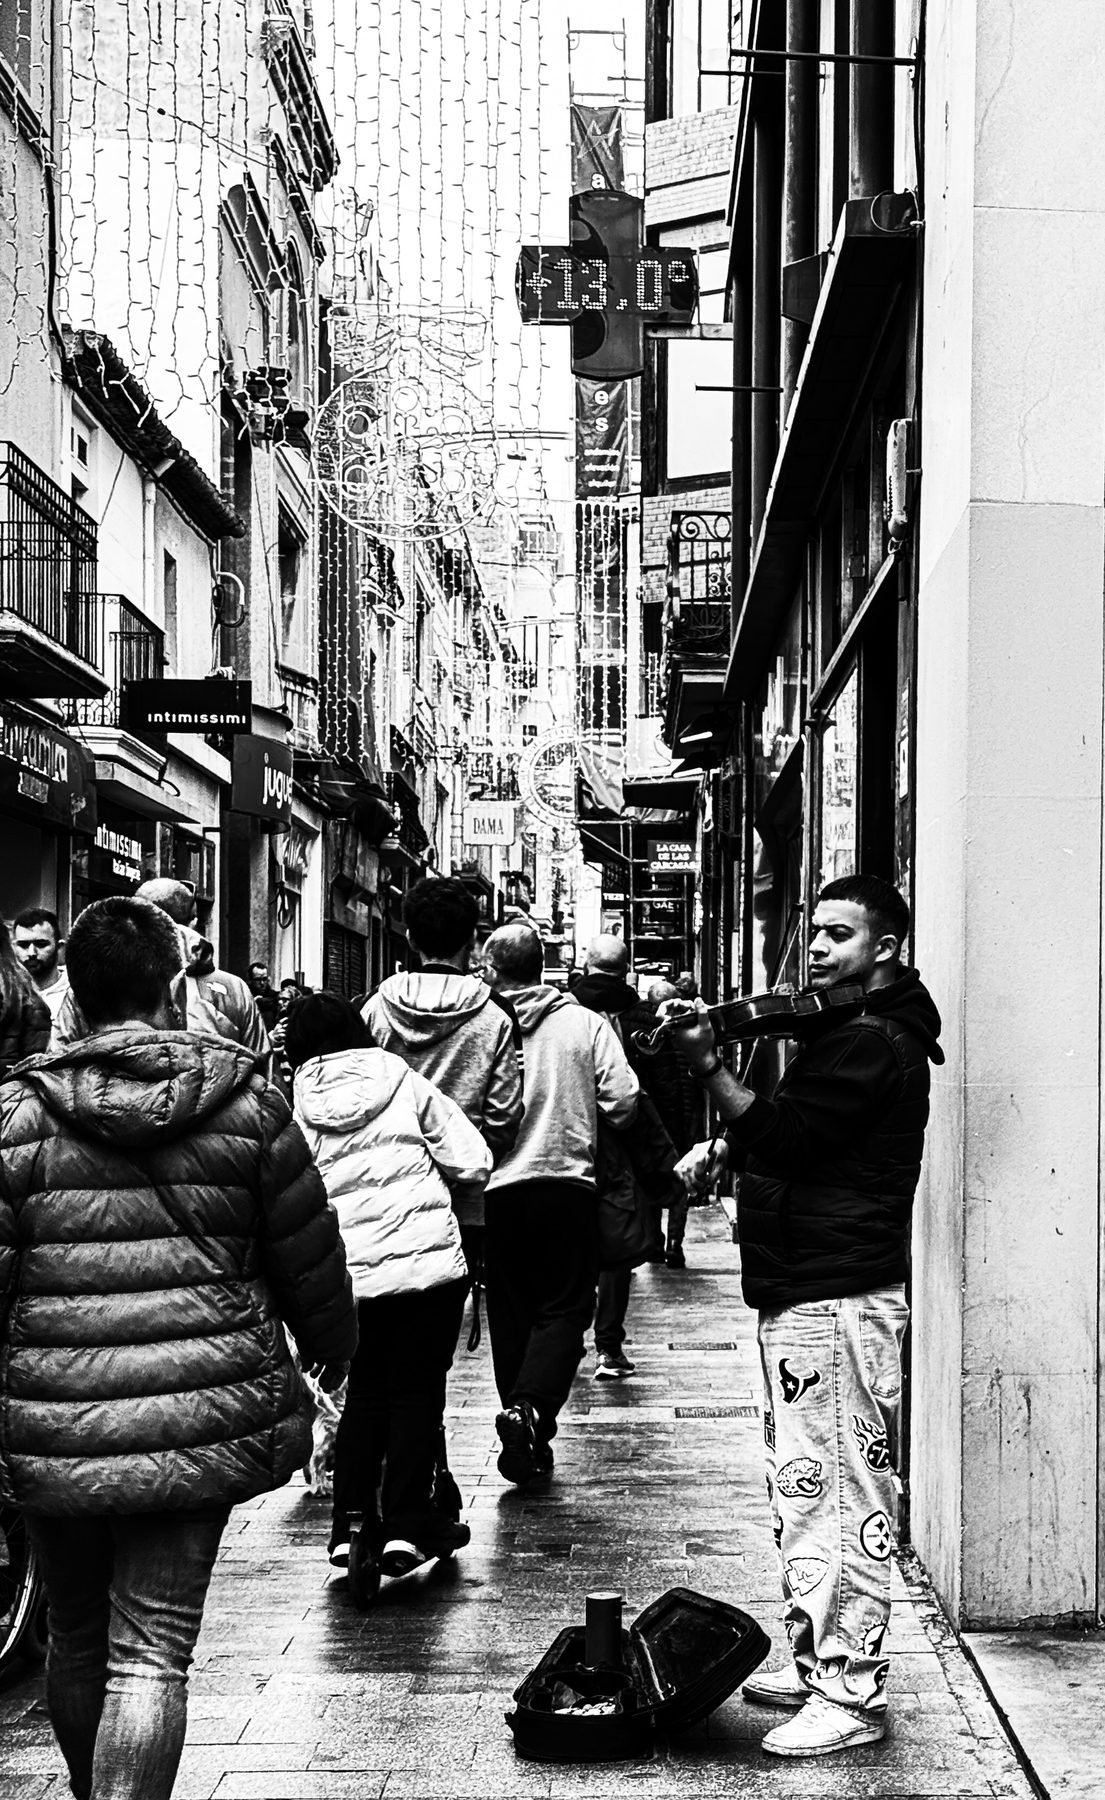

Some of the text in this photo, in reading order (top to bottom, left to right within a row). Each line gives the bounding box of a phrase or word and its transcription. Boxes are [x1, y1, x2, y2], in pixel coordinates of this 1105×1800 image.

[147, 711, 247, 724] intimissimi
[473, 817, 504, 835] DAMA
[656, 844, 692, 852] LA CASA
